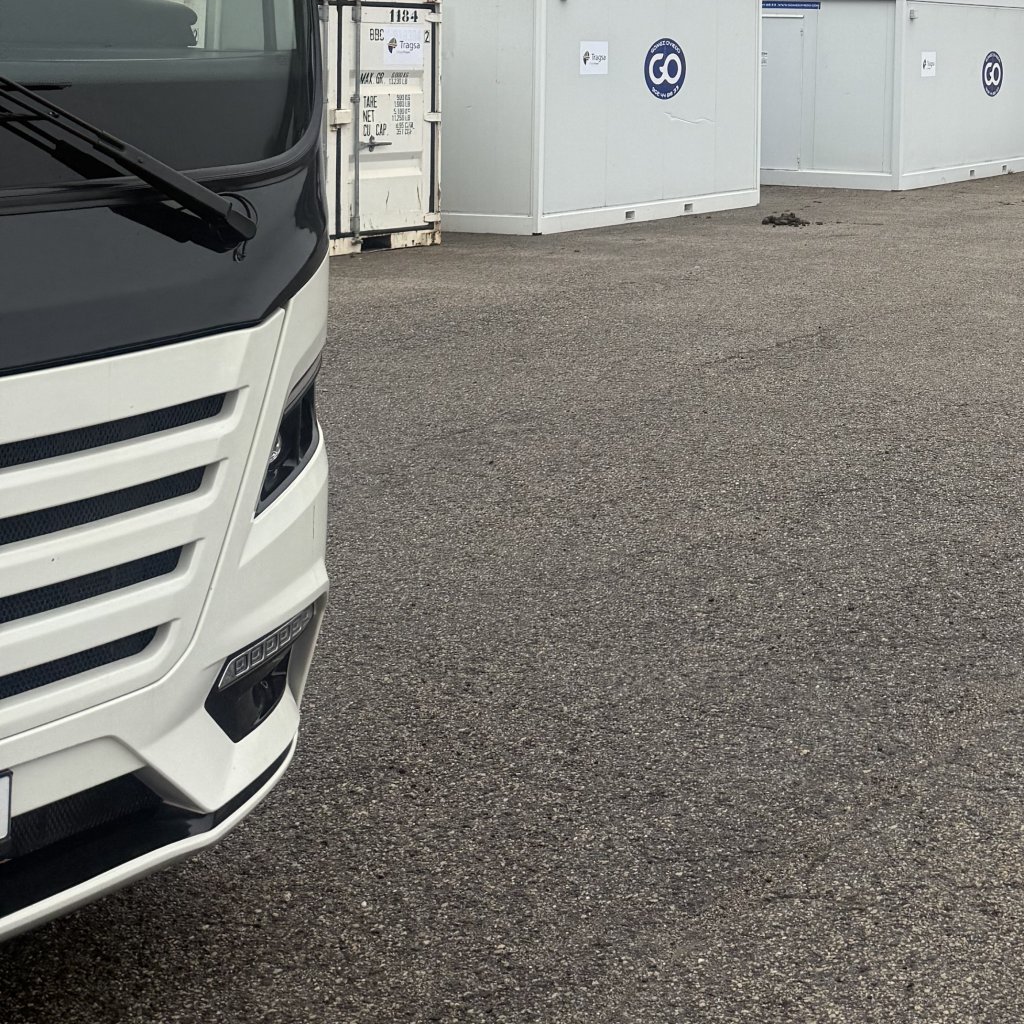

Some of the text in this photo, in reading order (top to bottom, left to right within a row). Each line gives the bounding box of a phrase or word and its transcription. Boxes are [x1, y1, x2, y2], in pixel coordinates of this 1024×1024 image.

[389, 9, 418, 23] 1184
[424, 30, 430, 43] 2
[399, 40, 421, 51] Tragsa
[591, 53, 607, 63] Tragsa
[363, 95, 378, 108] TARE
[362, 109, 375, 122] NET
